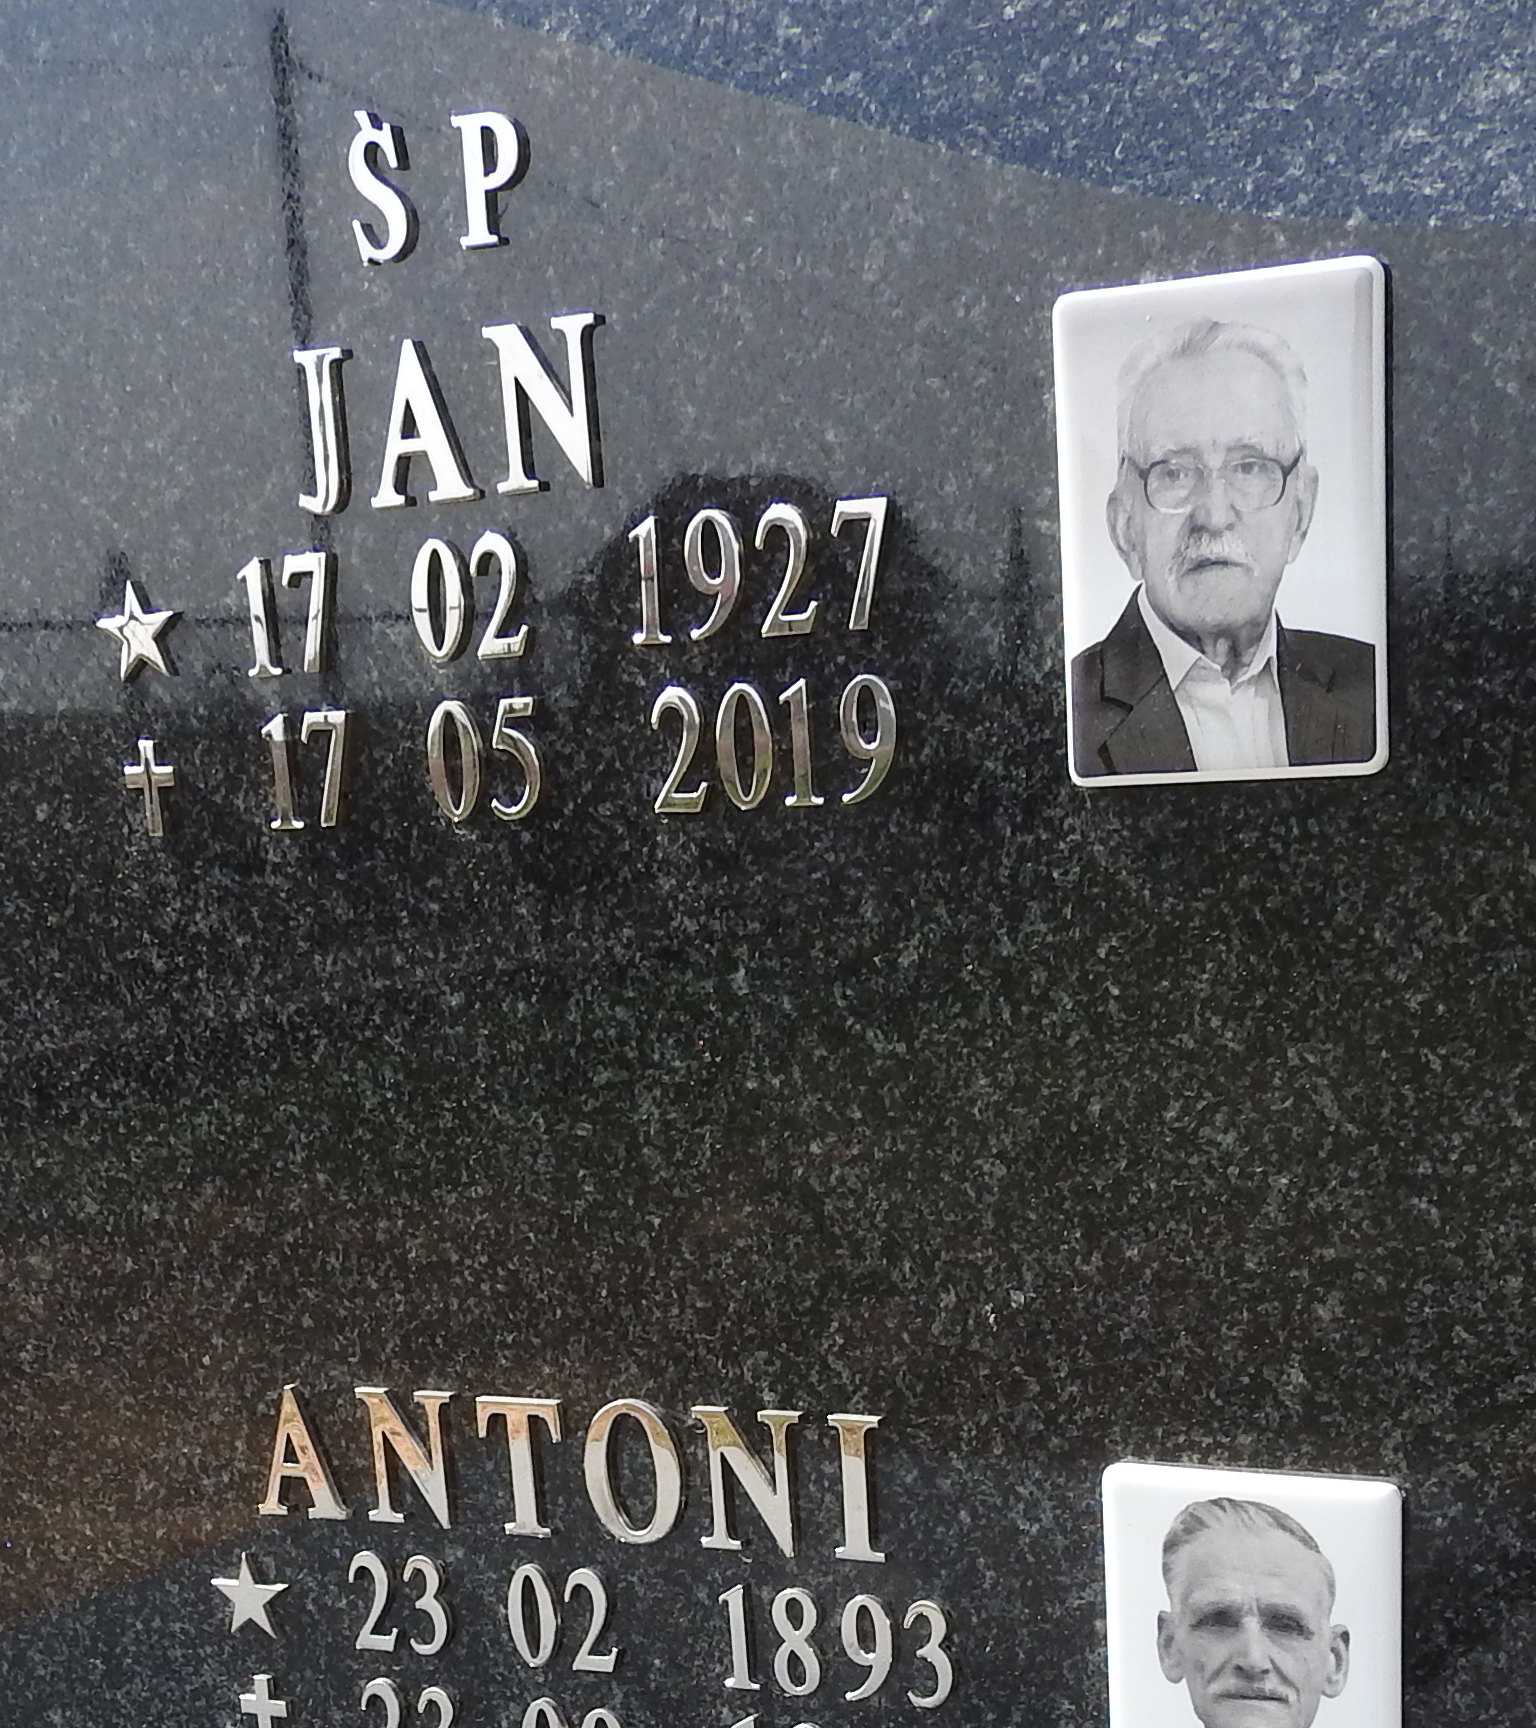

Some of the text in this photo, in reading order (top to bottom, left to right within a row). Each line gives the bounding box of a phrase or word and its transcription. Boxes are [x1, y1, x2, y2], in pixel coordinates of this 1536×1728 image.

[450, 110, 530, 249] P
[293, 312, 606, 516] JAN
[236, 497, 889, 677] 17 02 1927
[262, 673, 898, 830] 17 05 2019
[258, 1384, 888, 1562] ANTONI
[348, 1551, 955, 1708] 23 02 1893
